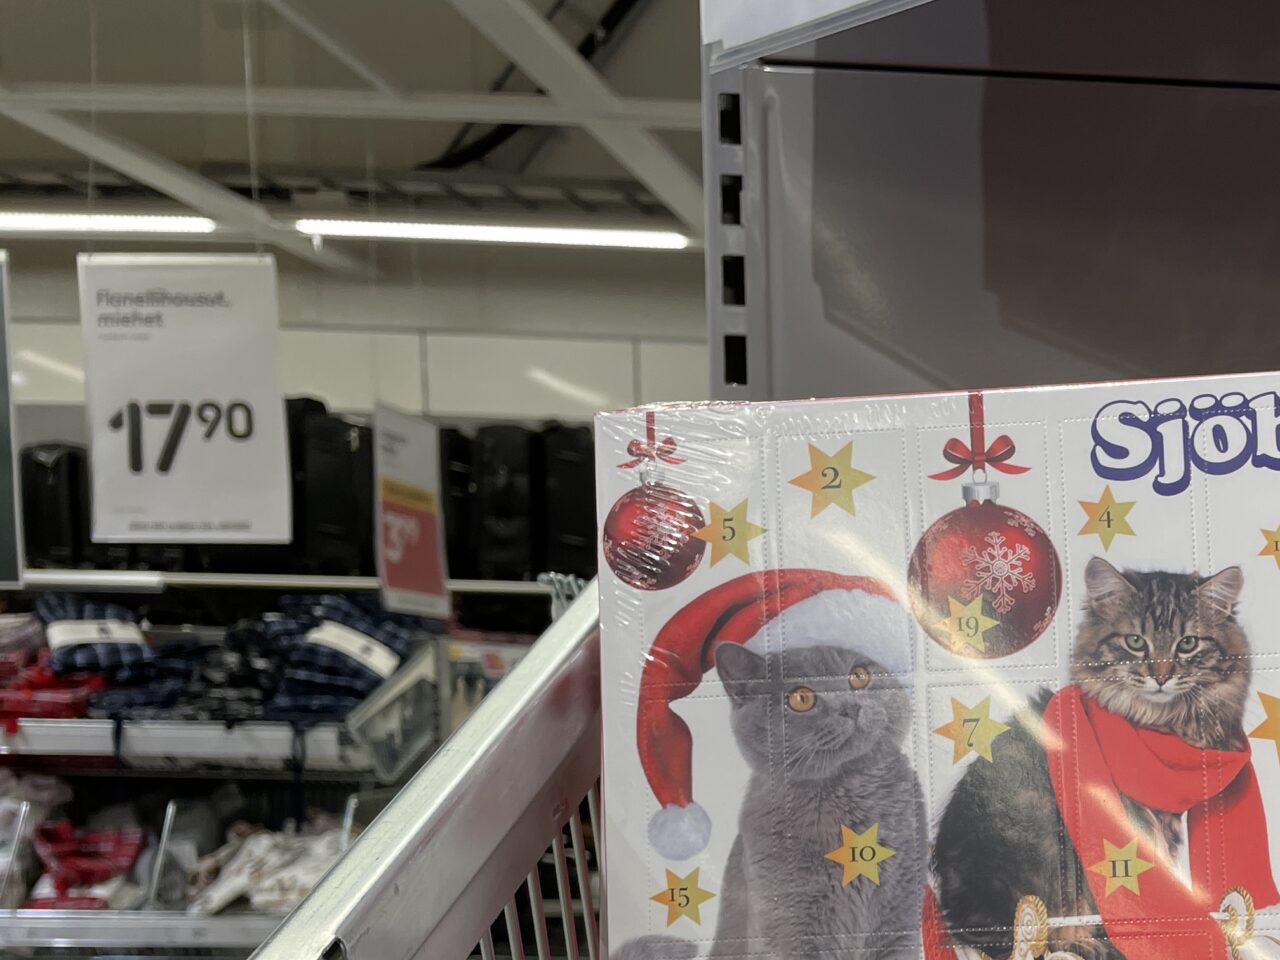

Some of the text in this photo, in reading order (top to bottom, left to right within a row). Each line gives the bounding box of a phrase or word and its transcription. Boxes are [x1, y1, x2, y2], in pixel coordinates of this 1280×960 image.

[820, 466, 842, 490] 2
[721, 517, 736, 542] 5
[1098, 505, 1113, 531] 4
[956, 616, 979, 638] 19
[962, 717, 981, 747] 7
[848, 845, 877, 863] 10
[669, 886, 690, 908] 15
